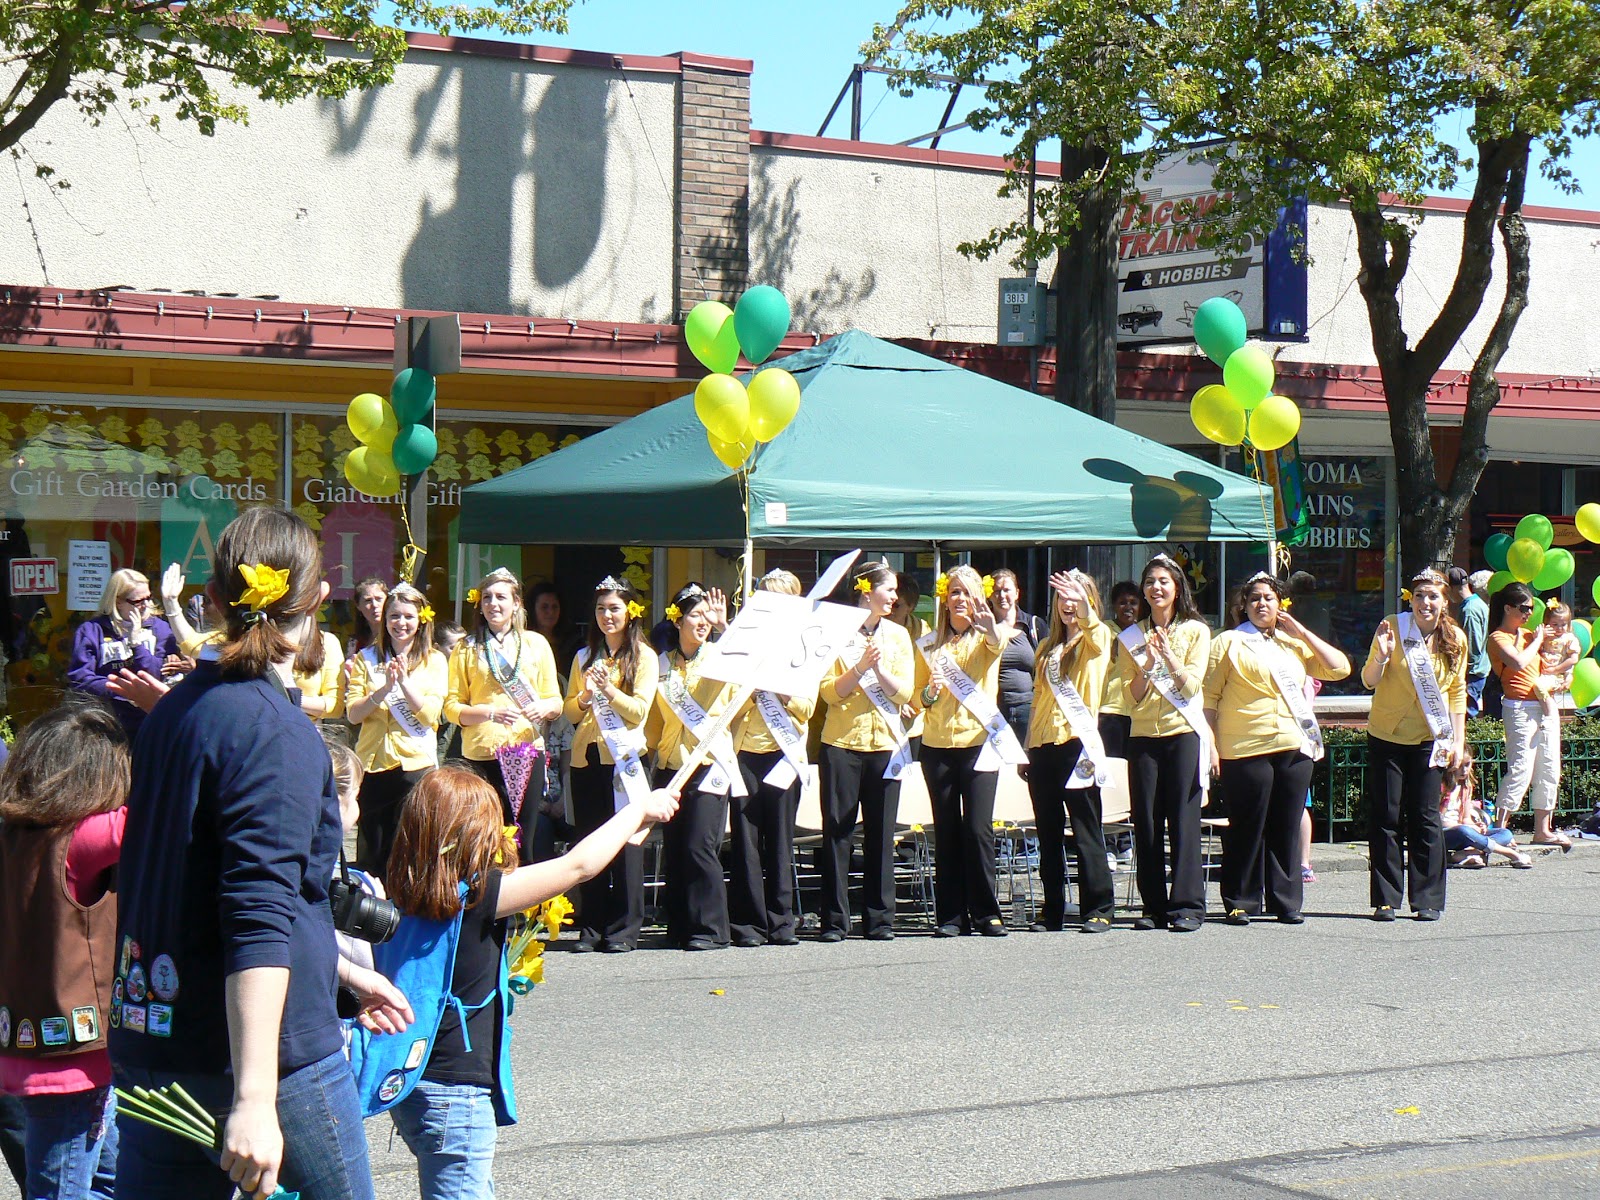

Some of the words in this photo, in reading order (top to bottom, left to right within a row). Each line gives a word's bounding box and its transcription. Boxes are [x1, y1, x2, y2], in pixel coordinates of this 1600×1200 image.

[1121, 192, 1234, 230] TACOM
[1118, 224, 1220, 258] TRAIN
[1141, 272, 1153, 287] &
[1158, 263, 1233, 285] HOBBIES
[1006, 293, 1026, 303] 3813
[10, 470, 65, 496] Gift
[76, 472, 180, 499] Garden
[189, 475, 267, 501] Cards
[1301, 462, 1363, 484] OMA
[303, 478, 407, 504] Giari
[13, 564, 57, 589] OPEN
[936, 656, 967, 693] Daffodil
